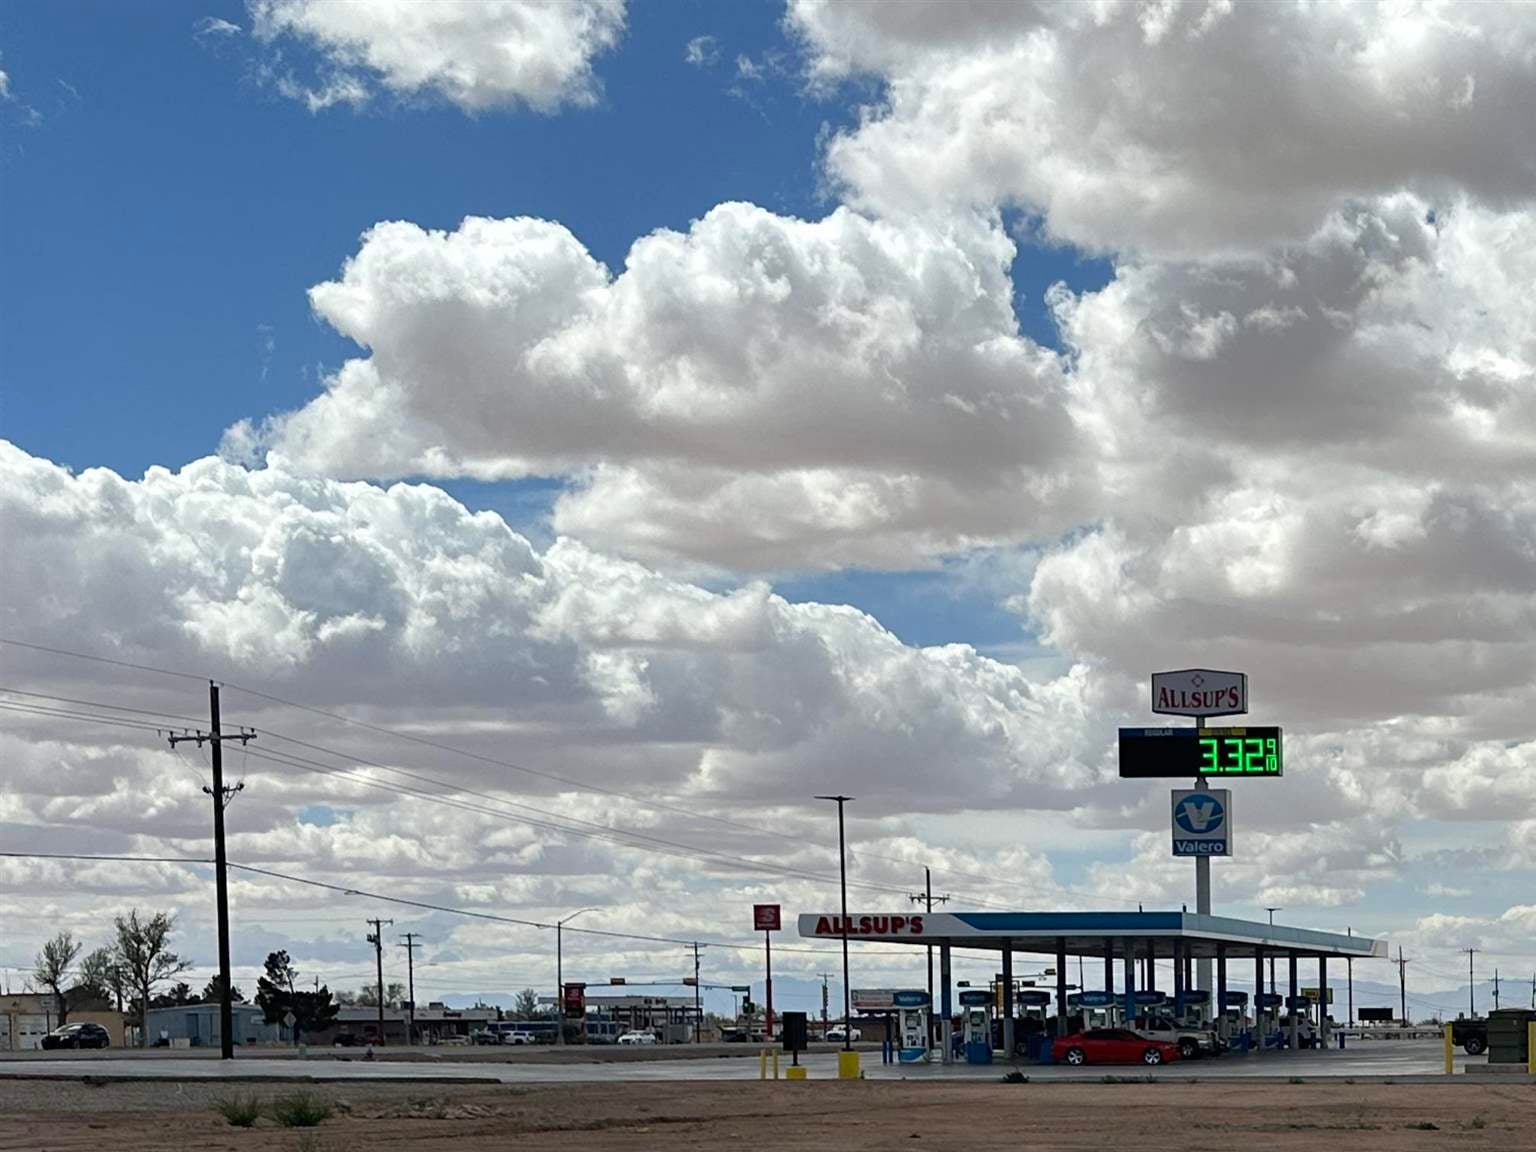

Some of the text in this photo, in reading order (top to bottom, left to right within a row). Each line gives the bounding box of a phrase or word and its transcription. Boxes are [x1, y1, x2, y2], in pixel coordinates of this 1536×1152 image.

[1158, 686, 1239, 708] ALLSUP'S
[1199, 738, 1264, 772] 3.32
[1176, 841, 1224, 853] Valero
[815, 916, 923, 934] ALLSUP'S
